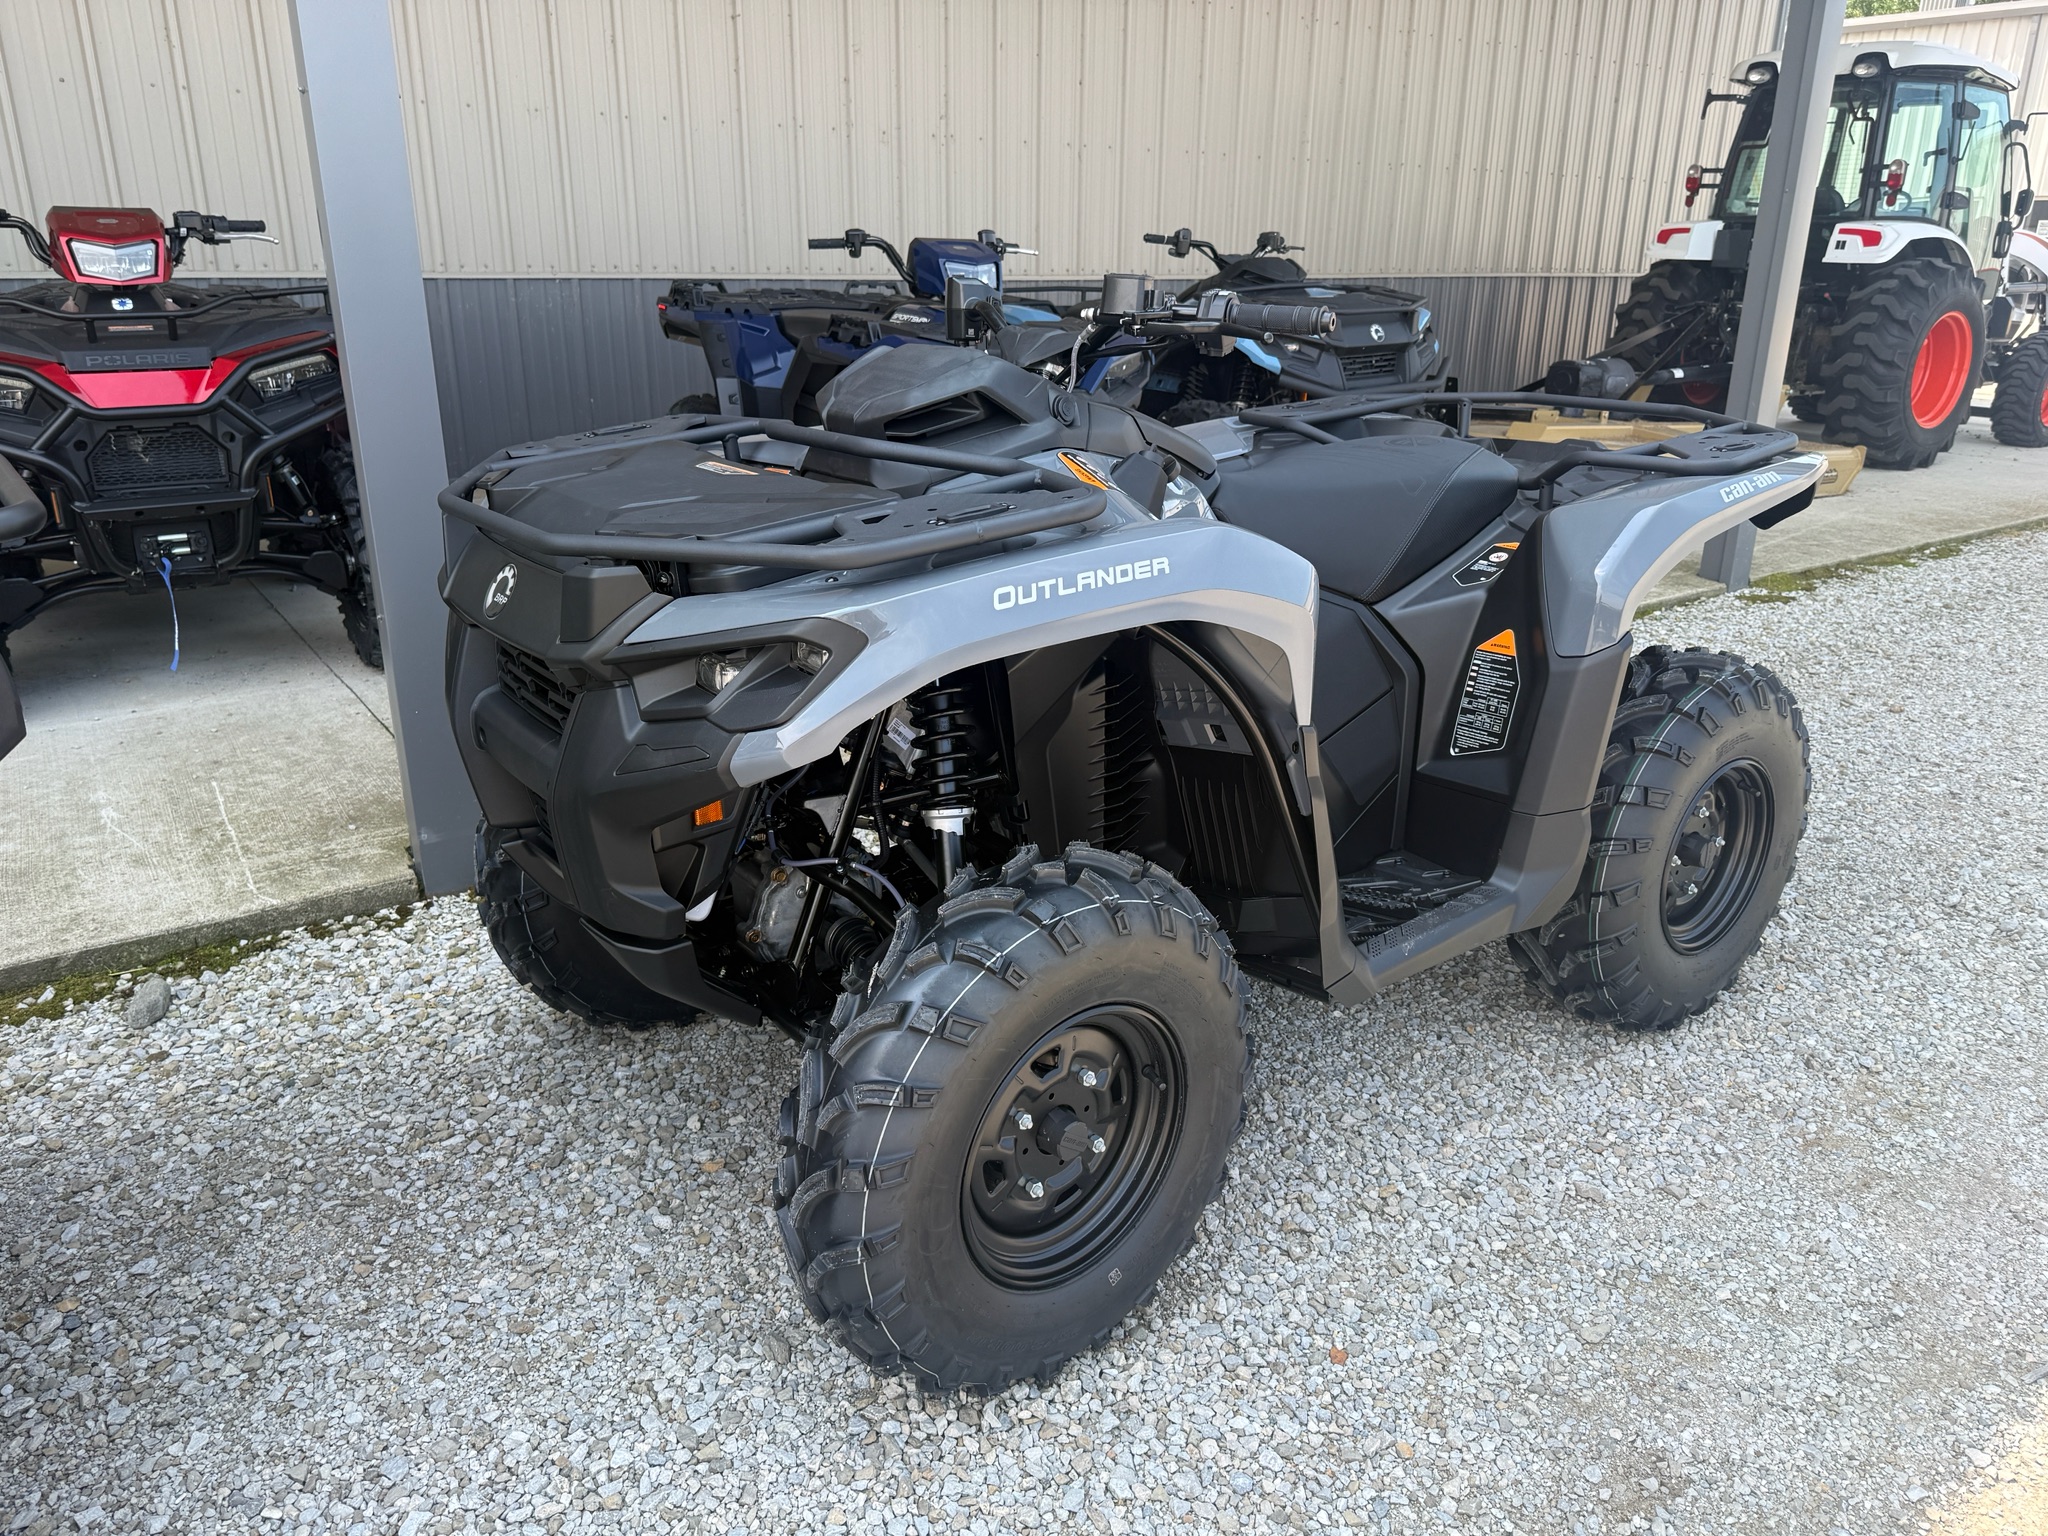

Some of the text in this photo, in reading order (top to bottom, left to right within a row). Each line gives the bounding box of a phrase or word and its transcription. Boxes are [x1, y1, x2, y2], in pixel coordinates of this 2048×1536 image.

[85, 352, 191, 367] POLARIS
[1719, 470, 1782, 503] can-am
[993, 557, 1170, 611] OUTLANDER
[494, 593, 508, 605] BRP
